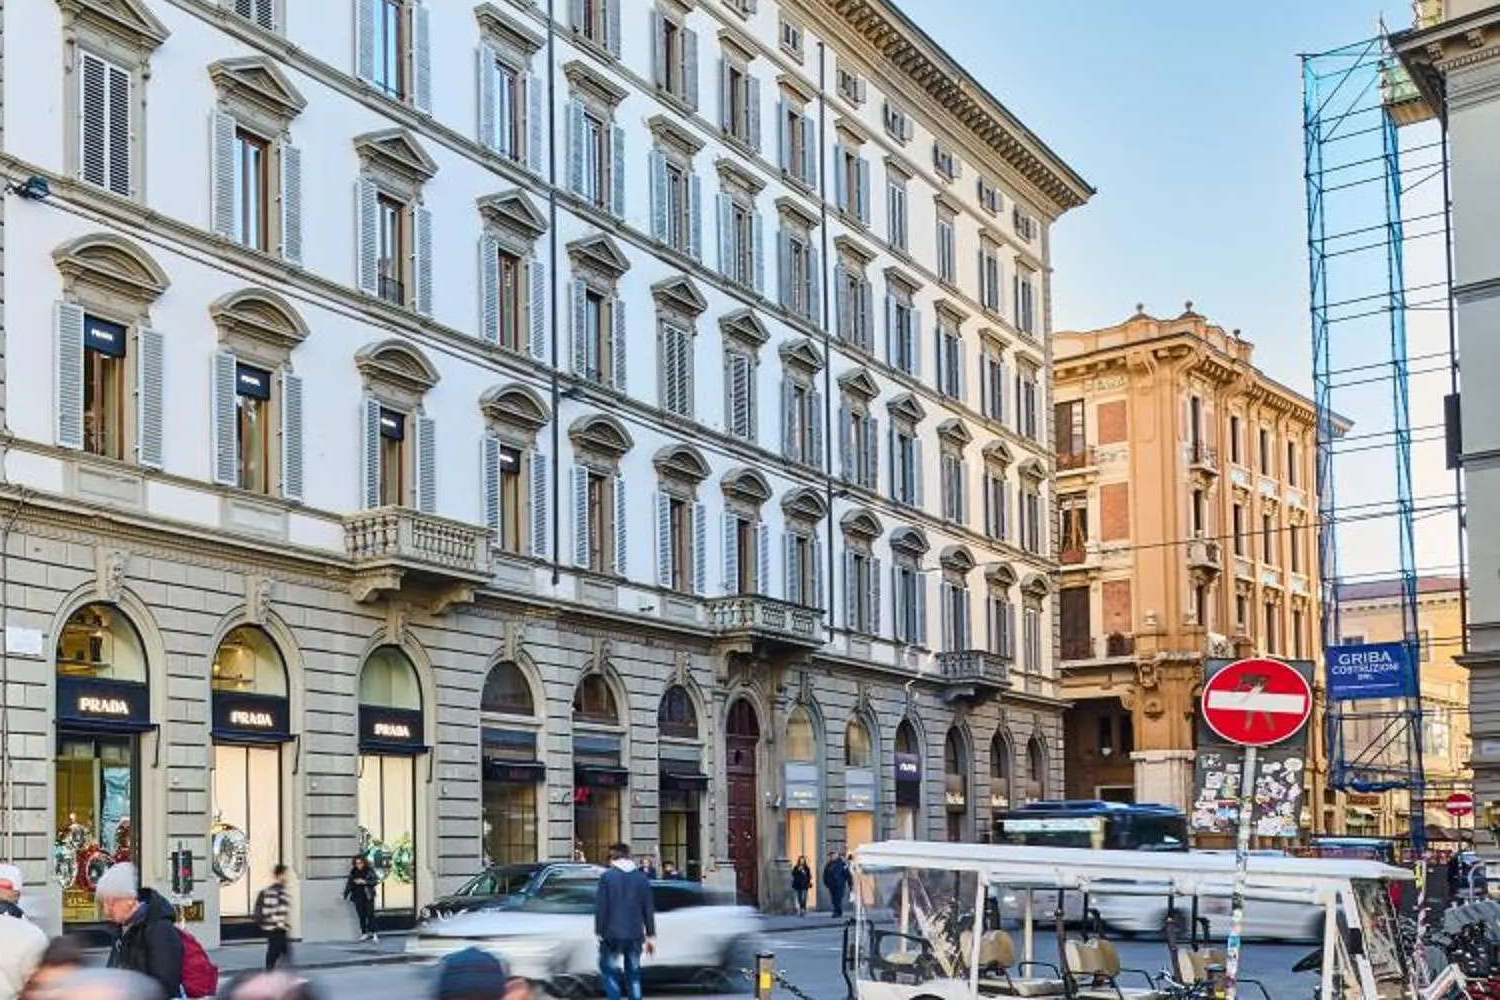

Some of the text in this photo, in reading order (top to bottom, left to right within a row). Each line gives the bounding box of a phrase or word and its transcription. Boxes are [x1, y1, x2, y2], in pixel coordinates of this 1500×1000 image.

[1338, 650, 1392, 665] GRIBA
[78, 697, 129, 715] PRADA
[230, 710, 273, 727] PRADA
[374, 723, 410, 738] PRADA
